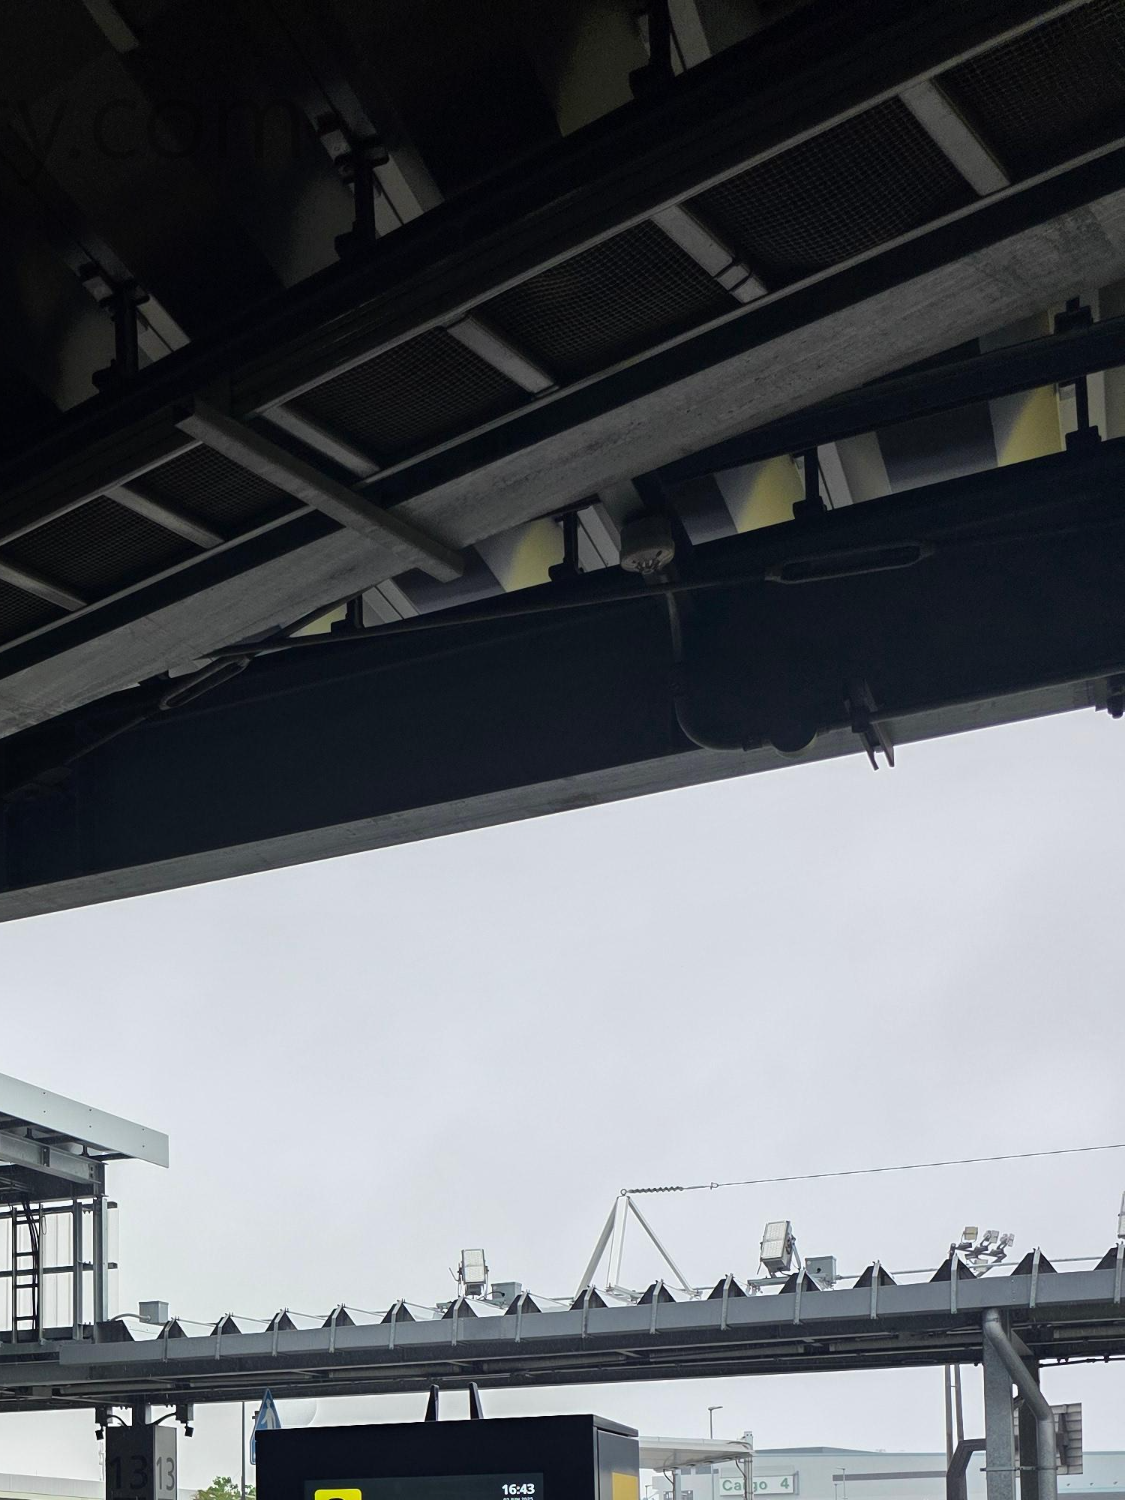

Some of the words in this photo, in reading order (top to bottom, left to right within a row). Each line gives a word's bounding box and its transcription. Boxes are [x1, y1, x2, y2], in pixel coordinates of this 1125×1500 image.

[111, 1455, 148, 1490] 13
[156, 1456, 175, 1491] 13
[780, 1477, 790, 1489] 4
[501, 1483, 536, 1495] 16:43
